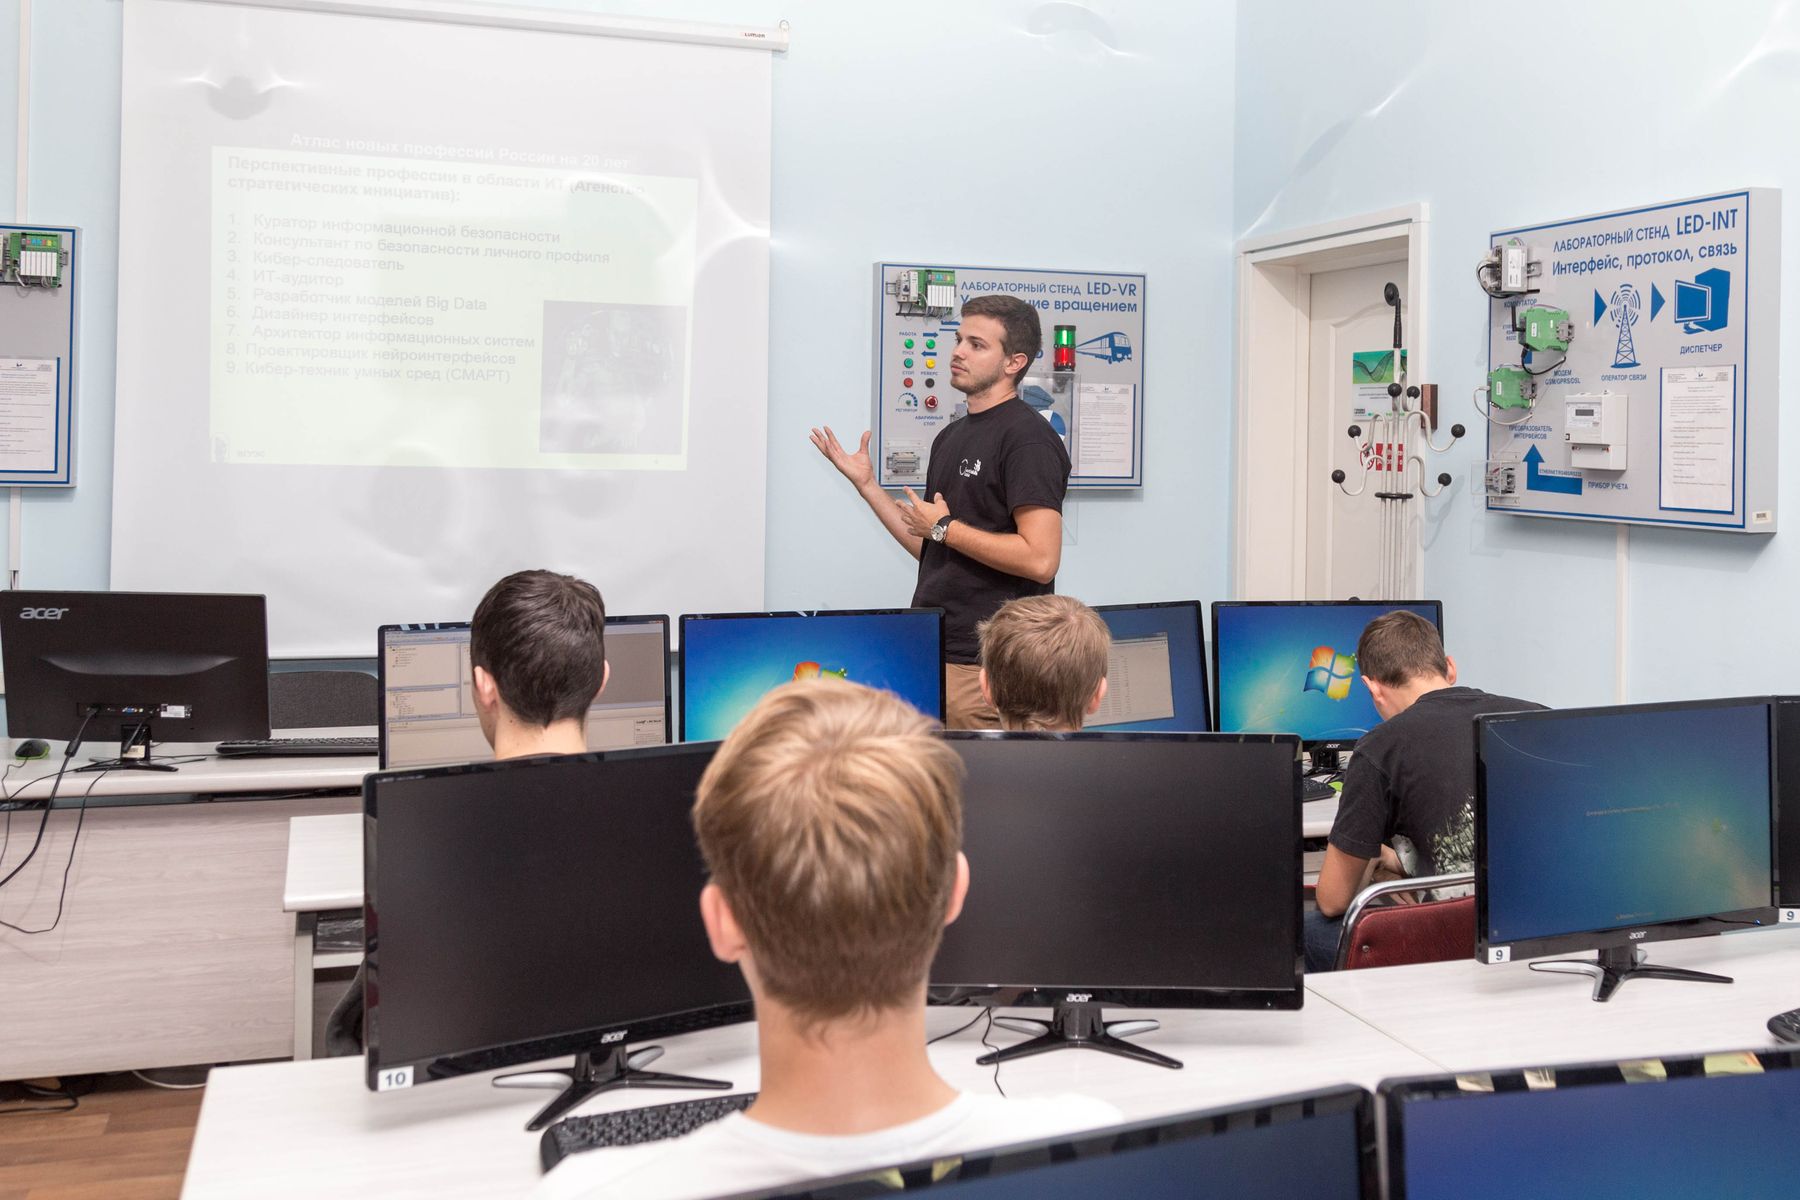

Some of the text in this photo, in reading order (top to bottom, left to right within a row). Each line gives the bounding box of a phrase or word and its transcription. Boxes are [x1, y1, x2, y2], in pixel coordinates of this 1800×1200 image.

[289, 133, 631, 169] Атлас новых профессий России на 20 лет
[228, 155, 361, 177] Перспективные
[366, 164, 458, 184] профессии
[462, 174, 471, 184] в
[477, 172, 540, 189] области
[545, 177, 565, 189] ИТ
[228, 175, 461, 203] стратегических инициатив):
[228, 213, 560, 243] 1. Куратор информационной безопасности
[1553, 208, 1738, 253] ЛАБОРАТОРНЫЙ СТЕНД LED-INT
[227, 231, 611, 264] 2. Консультант по безопасности личного профиля
[227, 250, 405, 271] 3. Кибер-следователь
[1552, 242, 1738, 276] Интерфейс, протокол, связь
[226, 268, 344, 287] 4. ИТ-аудитор
[961, 281, 1137, 296] ЛАБОРАТОРНЫЙ СТЕНД LED-VR
[226, 287, 487, 311] 5. Разработчик моделей Big Data
[1054, 300, 1137, 312] вращением
[226, 306, 434, 327] 6. Дизайнер интерфейсов
[226, 325, 535, 348] 7. Архитектор информационных систем
[246, 343, 369, 362] Проектировщик
[372, 349, 516, 365] нейроинтерфейсов
[1680, 343, 1723, 355] ДИСПЕТЧЕР
[245, 361, 349, 377] Кибер-техник
[354, 367, 401, 380] умных
[406, 369, 441, 382] сред
[446, 368, 511, 384] (СМАРТ)
[1601, 373, 1647, 382] ОПЕРАТОР СВЯЗИ
[1588, 481, 1611, 489] ПРИБОР
[20, 607, 70, 620] acer
[1786, 910, 1795, 921] 9
[1629, 931, 1648, 940] acer
[1495, 950, 1503, 961] 9
[1066, 993, 1092, 1003] acer
[601, 1029, 628, 1044] acer
[385, 1072, 406, 1087] 10
